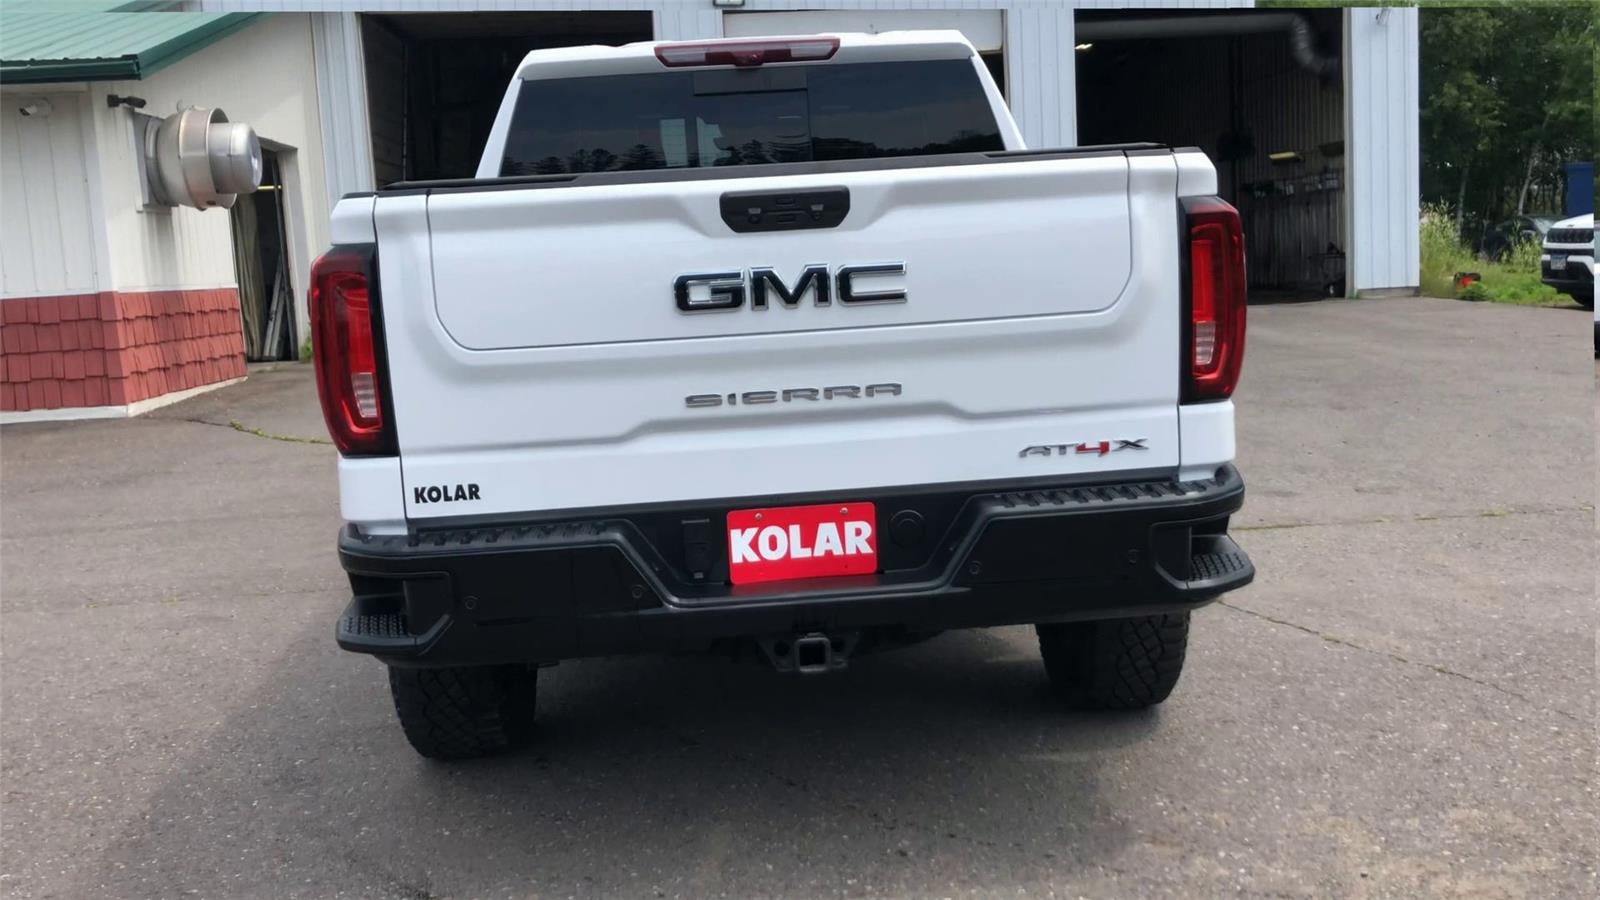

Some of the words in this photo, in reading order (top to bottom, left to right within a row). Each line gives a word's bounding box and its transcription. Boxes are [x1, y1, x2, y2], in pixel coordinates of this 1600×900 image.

[673, 261, 908, 315] GMC
[685, 383, 902, 408] SIERRA
[1019, 438, 1149, 458] AT4X
[414, 483, 481, 504] KOLAR
[730, 520, 874, 564] KOLAR
